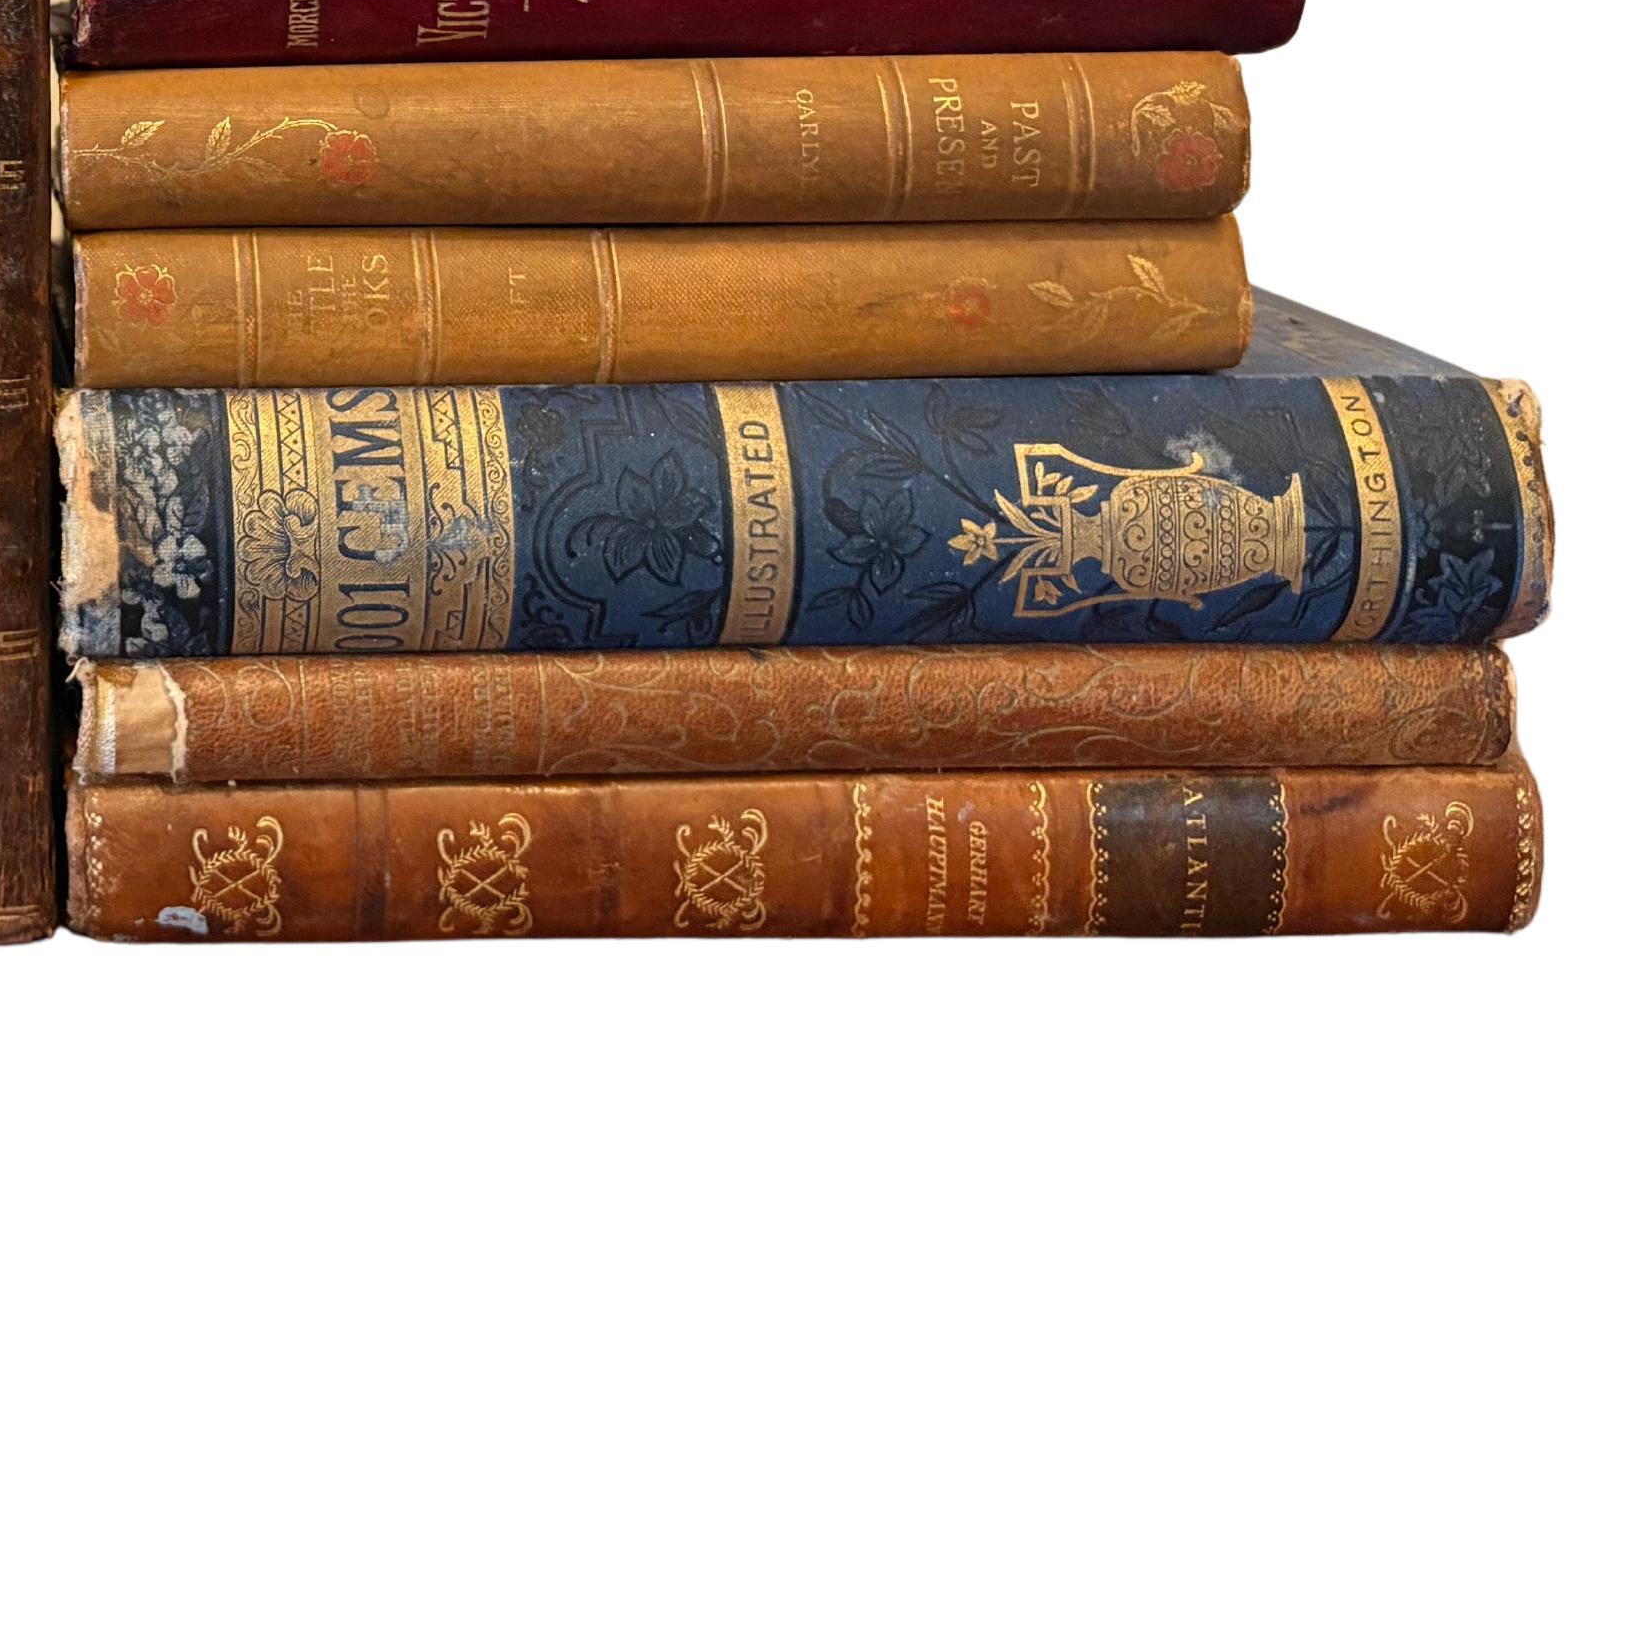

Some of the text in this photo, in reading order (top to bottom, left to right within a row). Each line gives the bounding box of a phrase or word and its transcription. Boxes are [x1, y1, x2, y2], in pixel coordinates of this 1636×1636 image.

[927, 77, 966, 194] PRESEN
[980, 118, 999, 169] AND
[1009, 99, 1042, 188] PAST
[325, 386, 410, 564] GEMS
[967, 819, 989, 926] GERHART
[1179, 785, 1209, 929] ATLANTI
